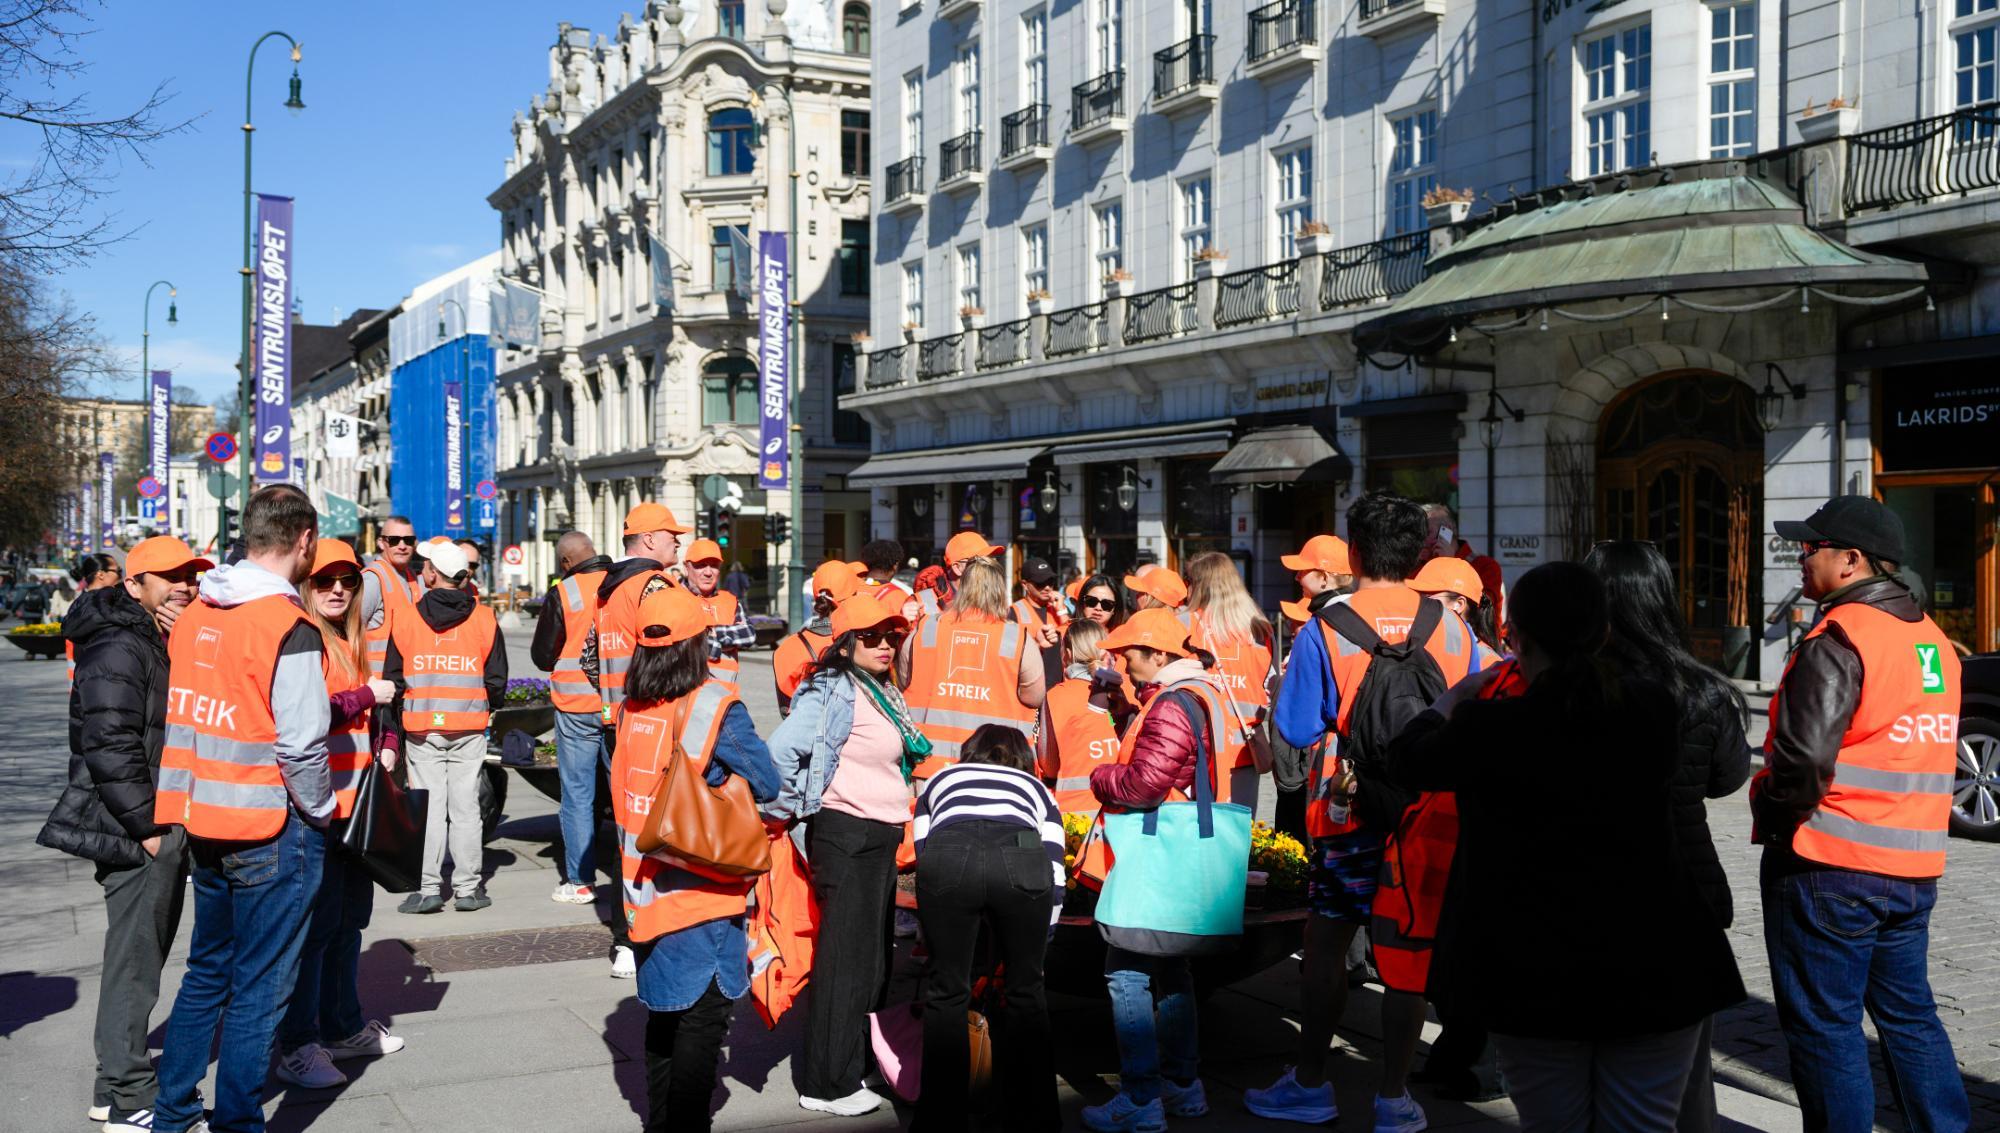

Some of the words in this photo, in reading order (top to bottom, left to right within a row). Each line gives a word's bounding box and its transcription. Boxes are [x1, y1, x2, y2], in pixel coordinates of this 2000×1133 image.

[807, 145, 818, 261] HOTEL
[260, 220, 288, 406] SENTRUMSLØPET
[764, 254, 784, 421] SENTRUMSLØPET
[1897, 405, 1988, 427] LAKRIDS
[447, 395, 461, 490] SENTRUMSLØPET
[1499, 536, 1540, 549] GRAND
[955, 635, 979, 645] parat
[413, 655, 478, 672] STREIK
[937, 682, 991, 701] STREIK
[632, 721, 655, 735] parat
